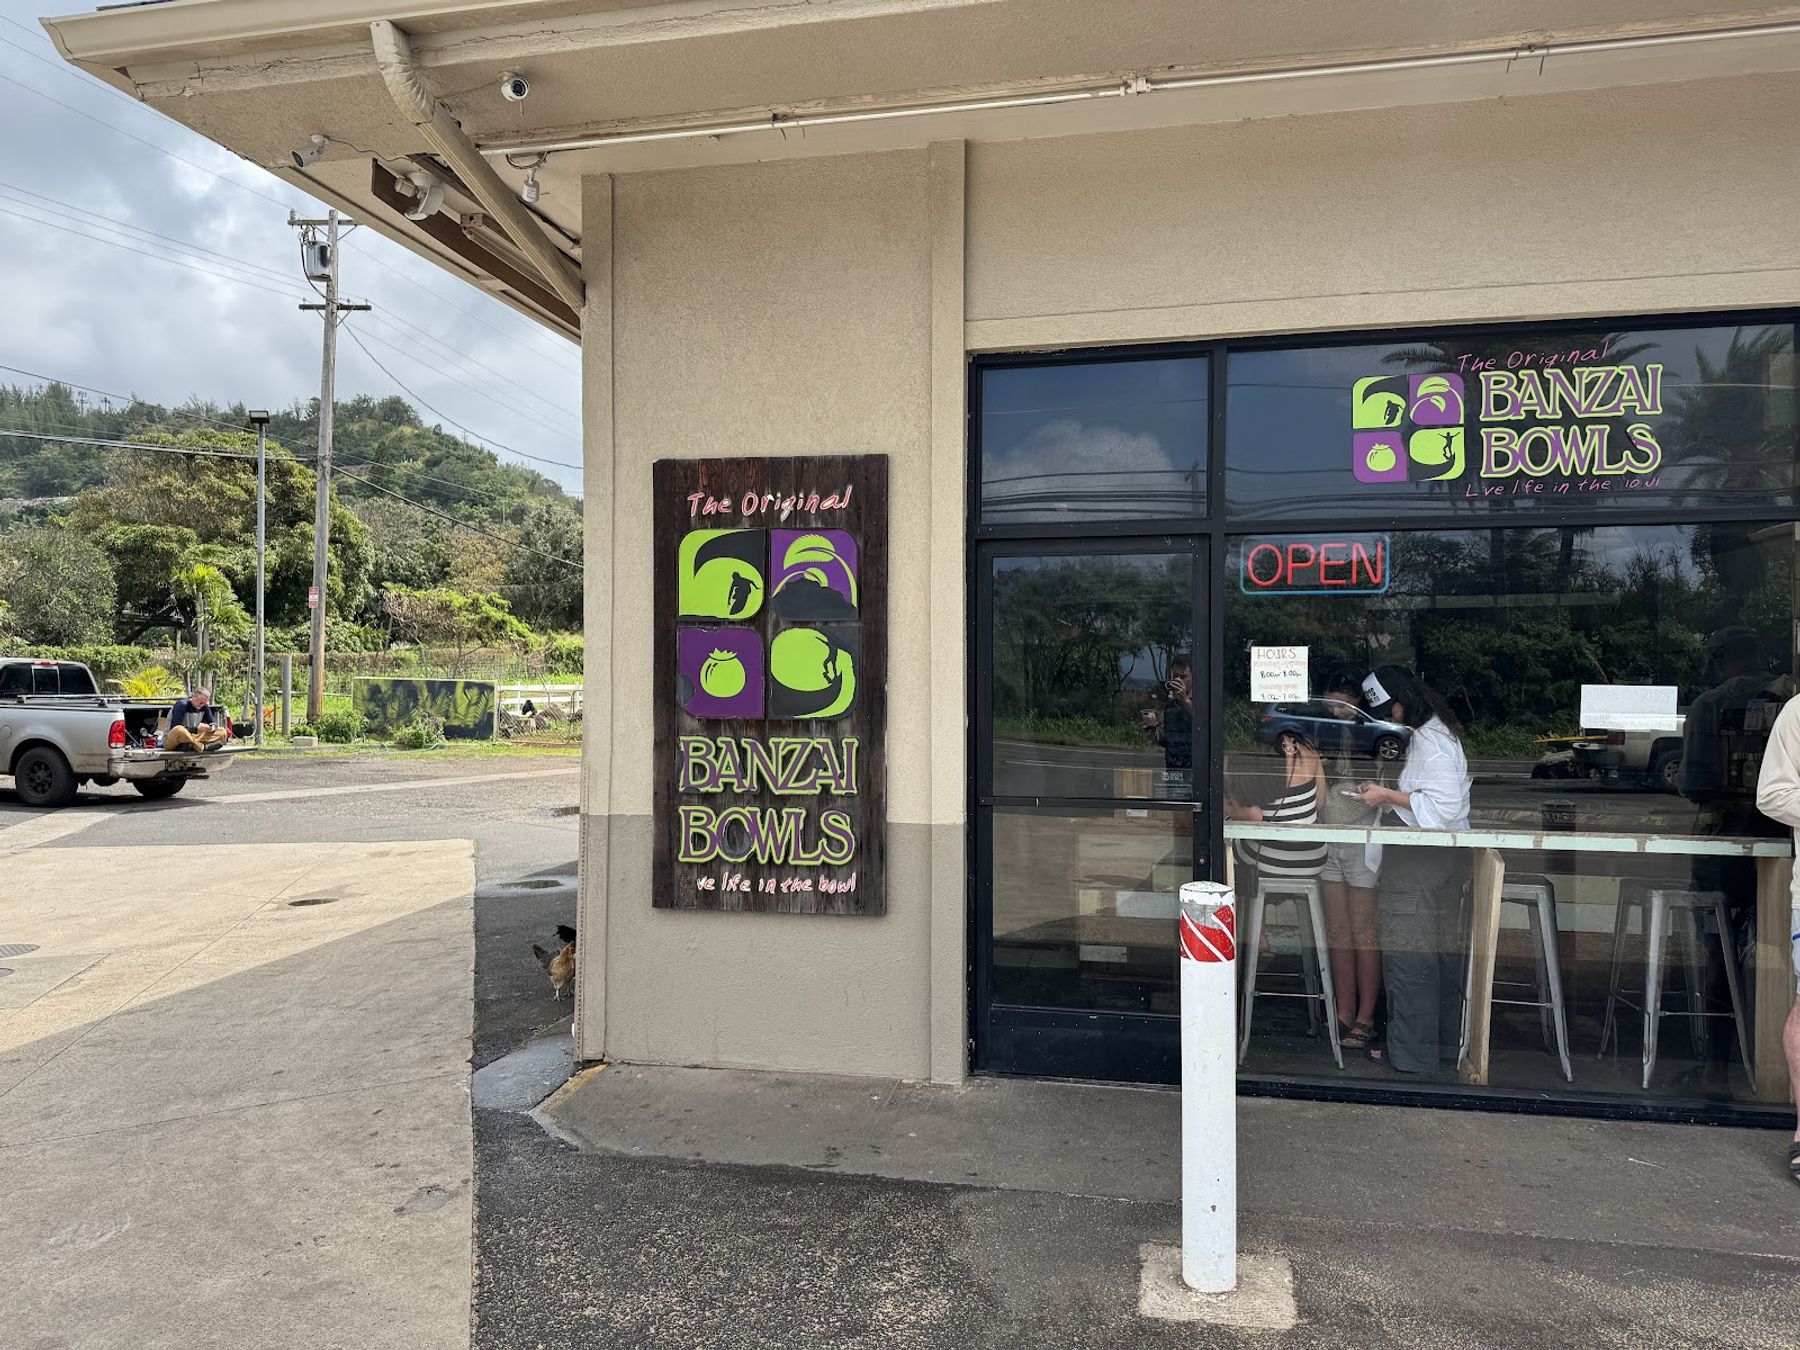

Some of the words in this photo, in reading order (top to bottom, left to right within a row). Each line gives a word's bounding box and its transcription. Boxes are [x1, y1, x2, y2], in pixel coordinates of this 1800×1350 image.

[1457, 353, 1497, 373] The
[1507, 340, 1609, 373] Original
[1479, 363, 1664, 422] BANZAI
[1480, 423, 1663, 478] BOWLS
[686, 491, 733, 518] The
[741, 484, 853, 522] Original
[1465, 483, 1504, 498] Lve
[1512, 479, 1544, 494] lfe
[1552, 481, 1570, 496] in
[1578, 478, 1611, 491] the
[1247, 542, 1384, 588] OPEN
[1257, 647, 1297, 660] HOURS
[679, 735, 859, 795] BANZAI
[678, 806, 856, 866] BOWLS
[721, 871, 752, 892] life
[758, 878, 777, 895] in
[780, 876, 813, 893] the
[818, 871, 857, 895] bowl
